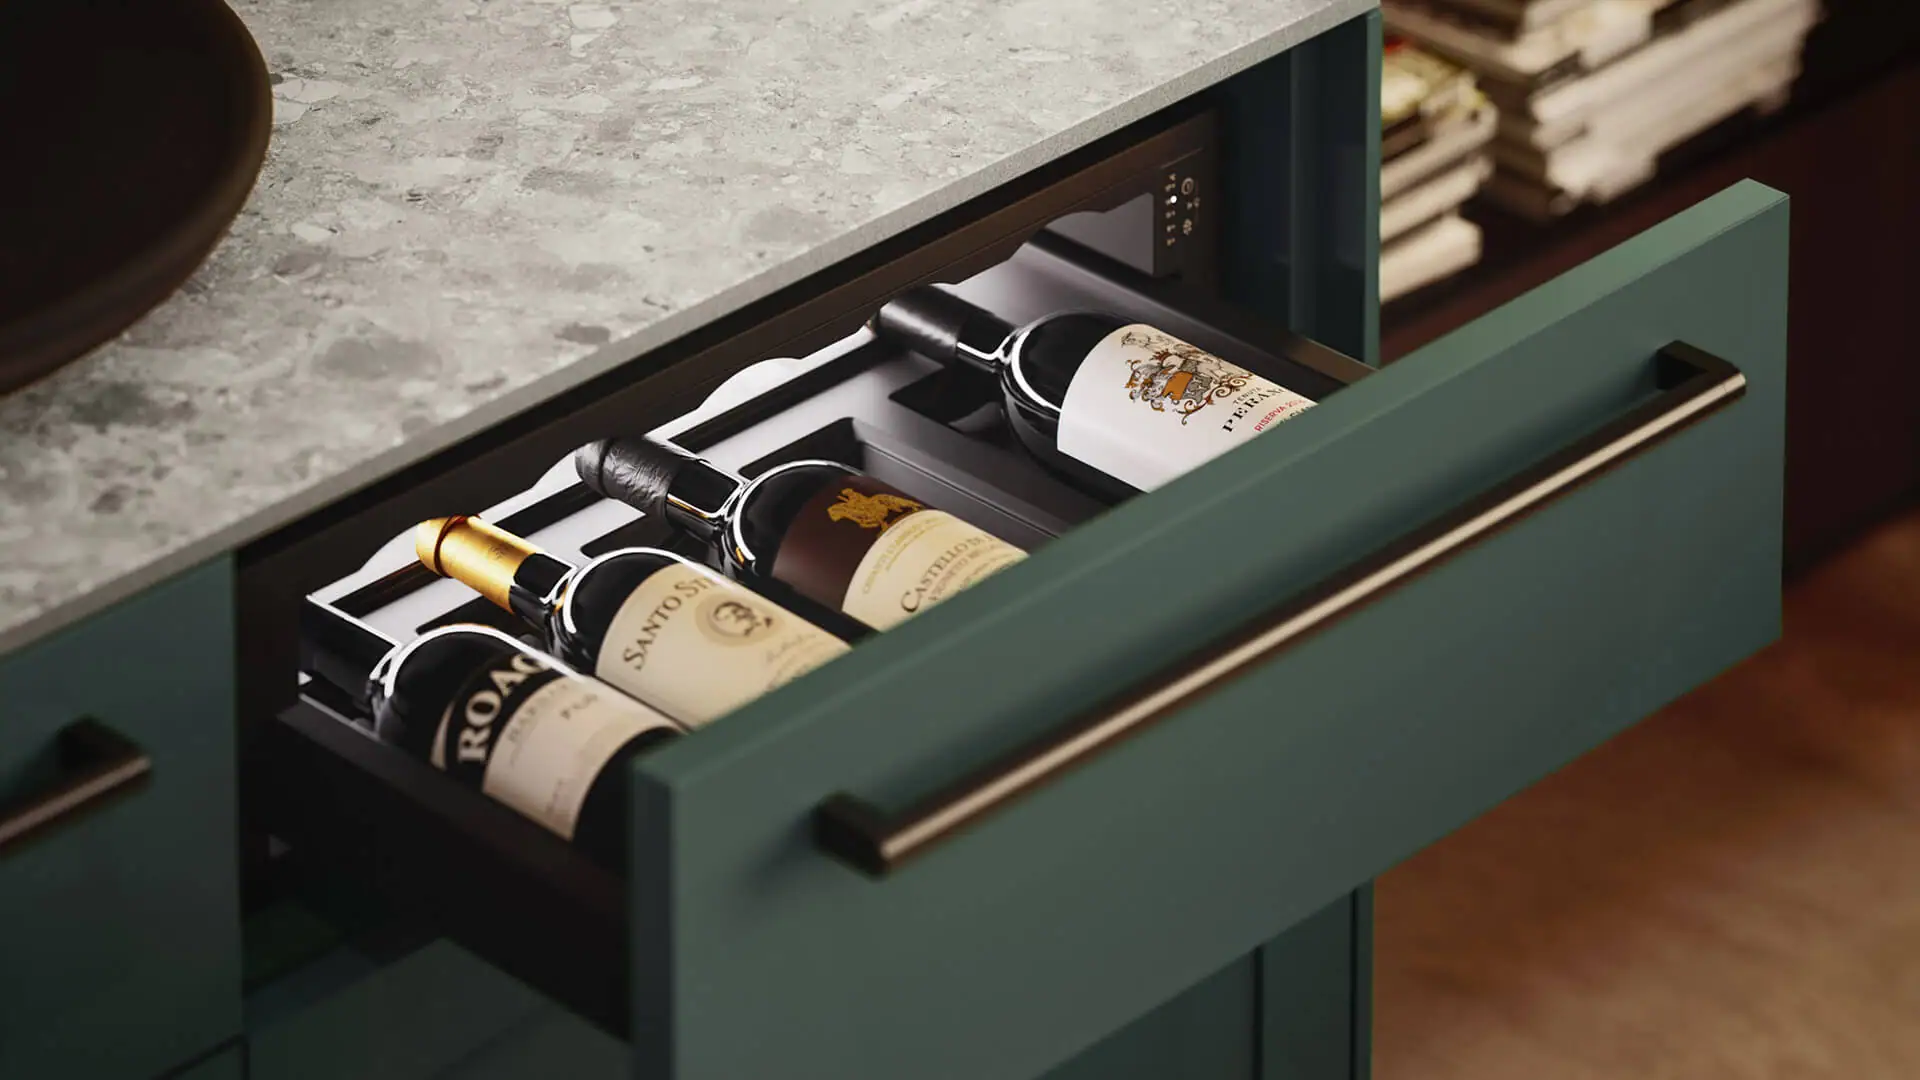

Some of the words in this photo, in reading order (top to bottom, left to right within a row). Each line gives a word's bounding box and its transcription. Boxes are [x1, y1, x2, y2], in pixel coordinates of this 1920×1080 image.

[1254, 405, 1286, 432] RISERVA
[901, 542, 968, 613] CASTELLO
[623, 596, 682, 671] SANTO
